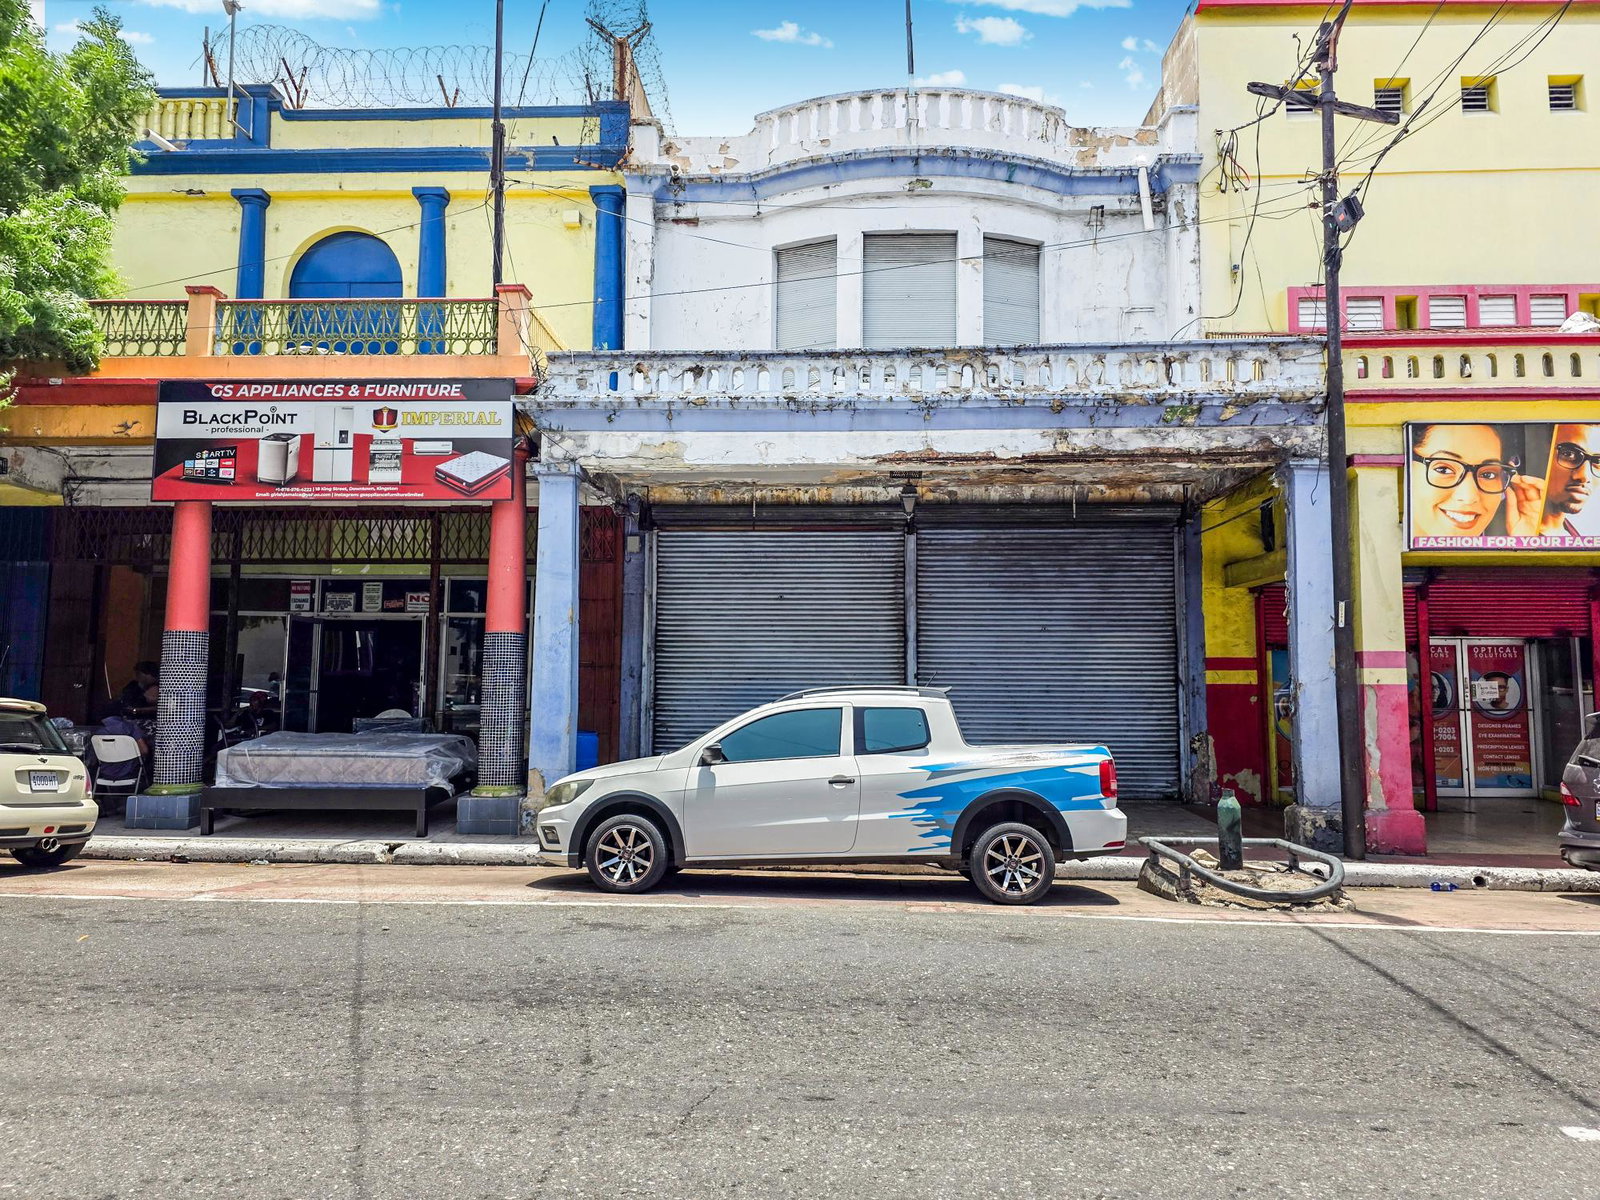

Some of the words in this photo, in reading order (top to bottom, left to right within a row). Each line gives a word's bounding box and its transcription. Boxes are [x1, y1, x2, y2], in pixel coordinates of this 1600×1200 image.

[211, 384, 233, 398] GS
[235, 384, 345, 398] APPLIANCES
[348, 384, 360, 397] &
[364, 383, 463, 397] FURNITURE
[401, 411, 502, 426] IMPERIAL
[211, 425, 264, 434] professional
[1418, 537, 1484, 547] FASHION
[1487, 536, 1517, 547] FOR
[1520, 536, 1562, 547] YOUR
